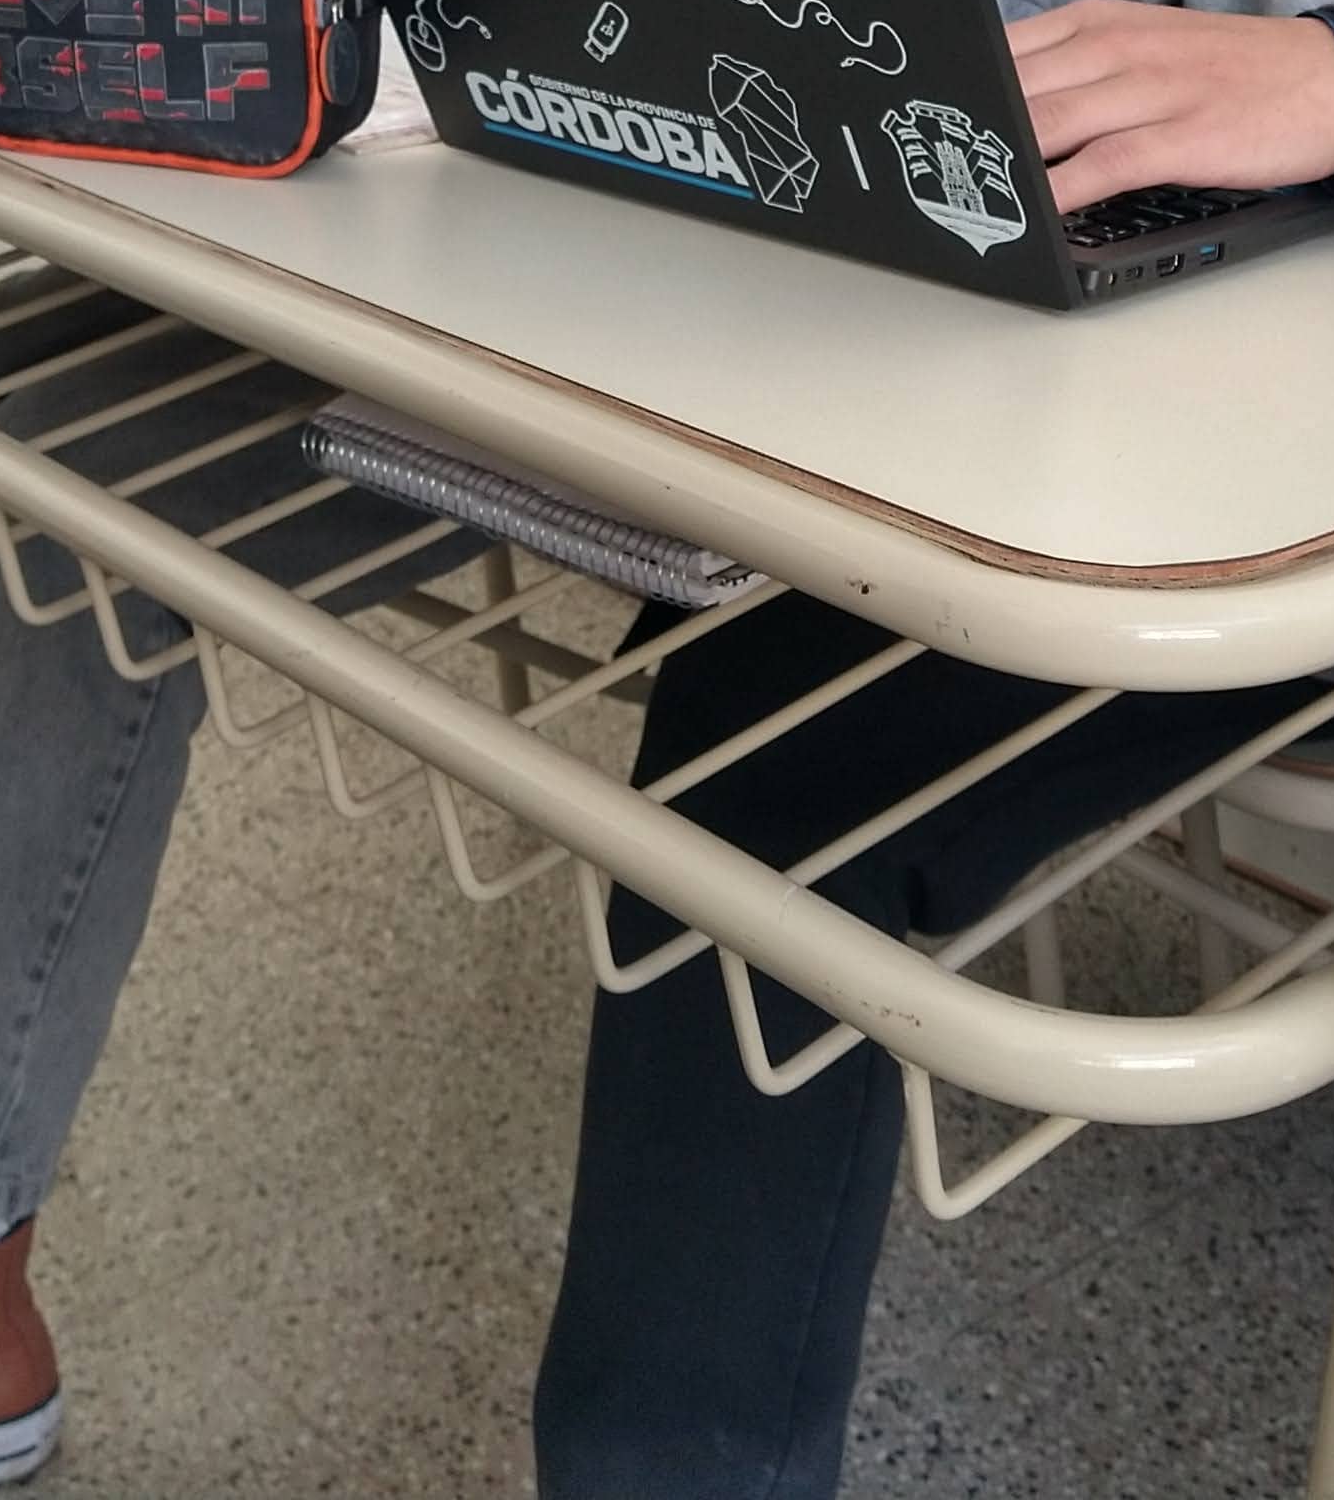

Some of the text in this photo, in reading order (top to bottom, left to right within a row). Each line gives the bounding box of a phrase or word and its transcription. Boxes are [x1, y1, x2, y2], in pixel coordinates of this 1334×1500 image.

[465, 68, 750, 187] CÓRDOBA
[528, 74, 717, 130] GOBIERNO DE LA PROVINCIA DE
